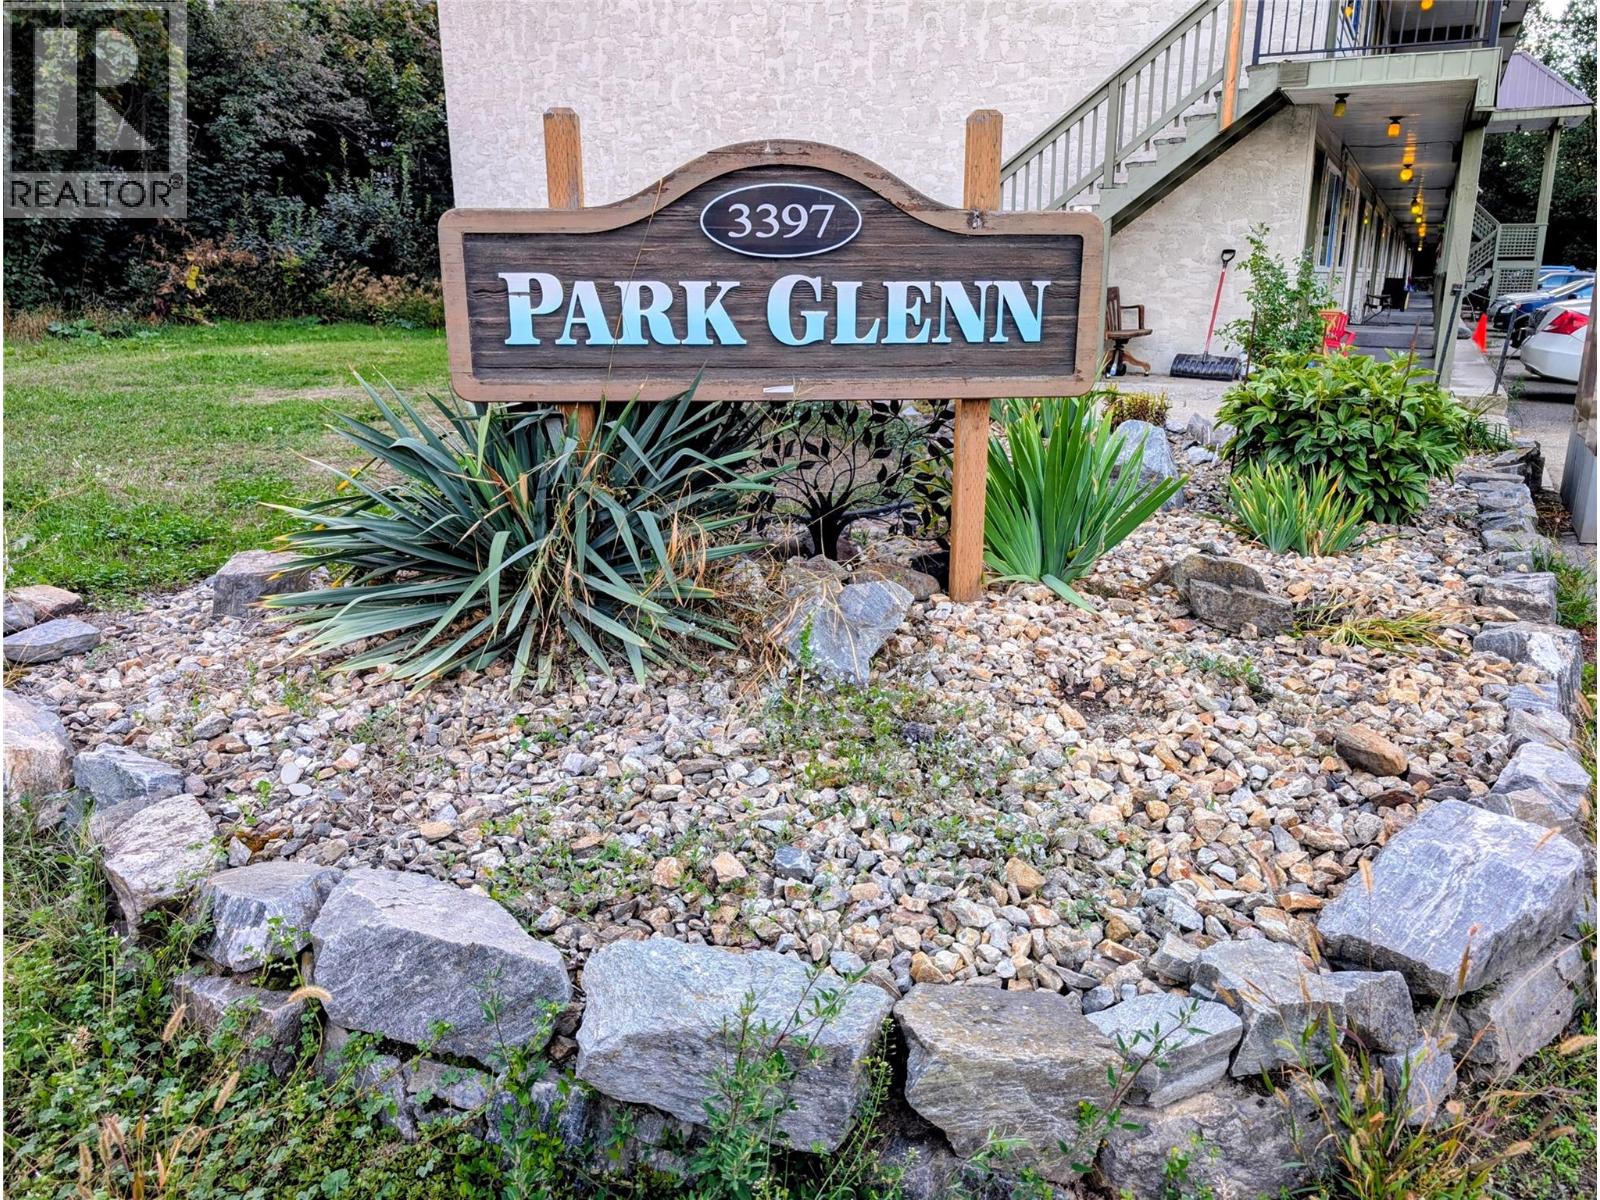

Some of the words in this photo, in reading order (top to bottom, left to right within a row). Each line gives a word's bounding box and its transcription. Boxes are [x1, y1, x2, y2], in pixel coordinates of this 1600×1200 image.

[727, 203, 836, 239] 3397
[498, 272, 747, 346] PARK
[766, 274, 1052, 346] GLENN
